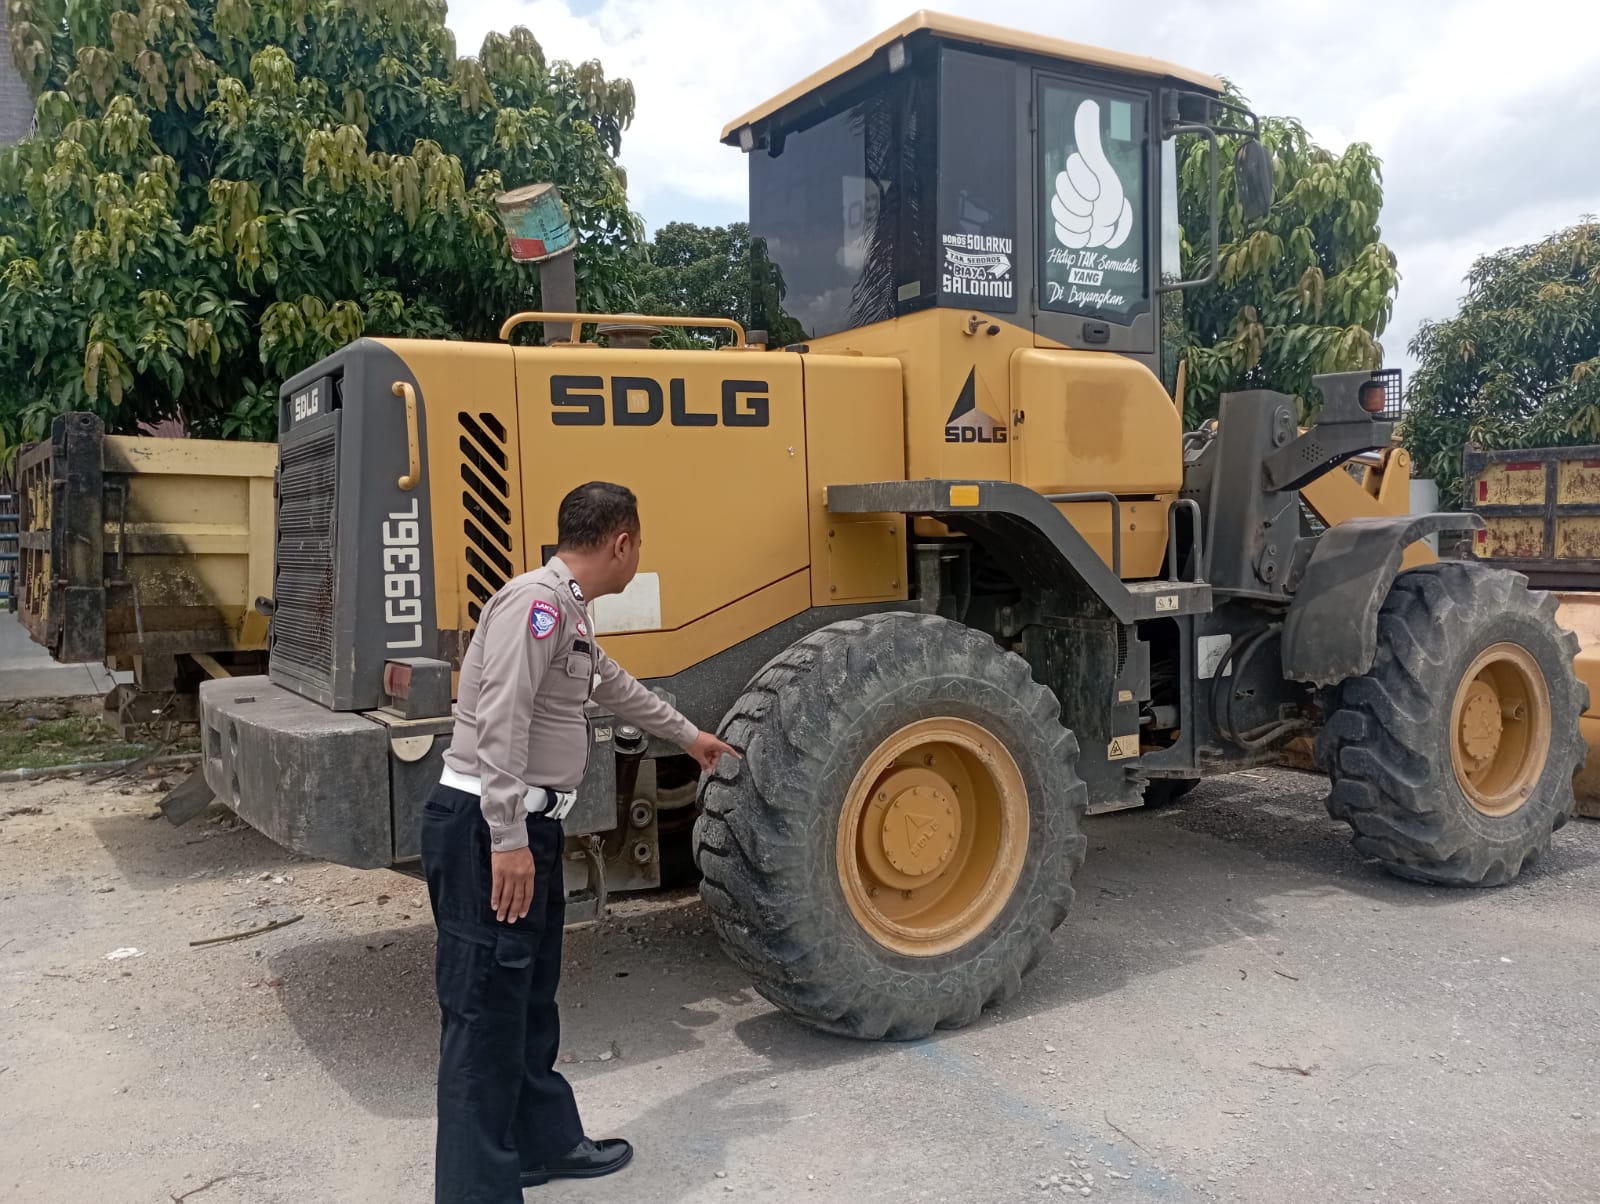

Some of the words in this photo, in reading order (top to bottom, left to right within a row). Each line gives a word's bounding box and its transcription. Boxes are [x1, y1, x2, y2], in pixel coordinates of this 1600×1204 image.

[967, 234, 1012, 254] SOLARKU
[953, 264, 987, 280] BIAYA
[1047, 248, 1077, 270] Hidup
[1077, 251, 1098, 268] TAK
[1096, 254, 1142, 273] Semudah
[1073, 270, 1101, 283] YANG
[1047, 281, 1065, 304] Di
[1067, 285, 1127, 309] Bayangkan
[295, 388, 319, 422] SDLG
[550, 374, 770, 427] SDLG
[944, 426, 1008, 443] SDLG
[382, 497, 423, 649] LG936L
